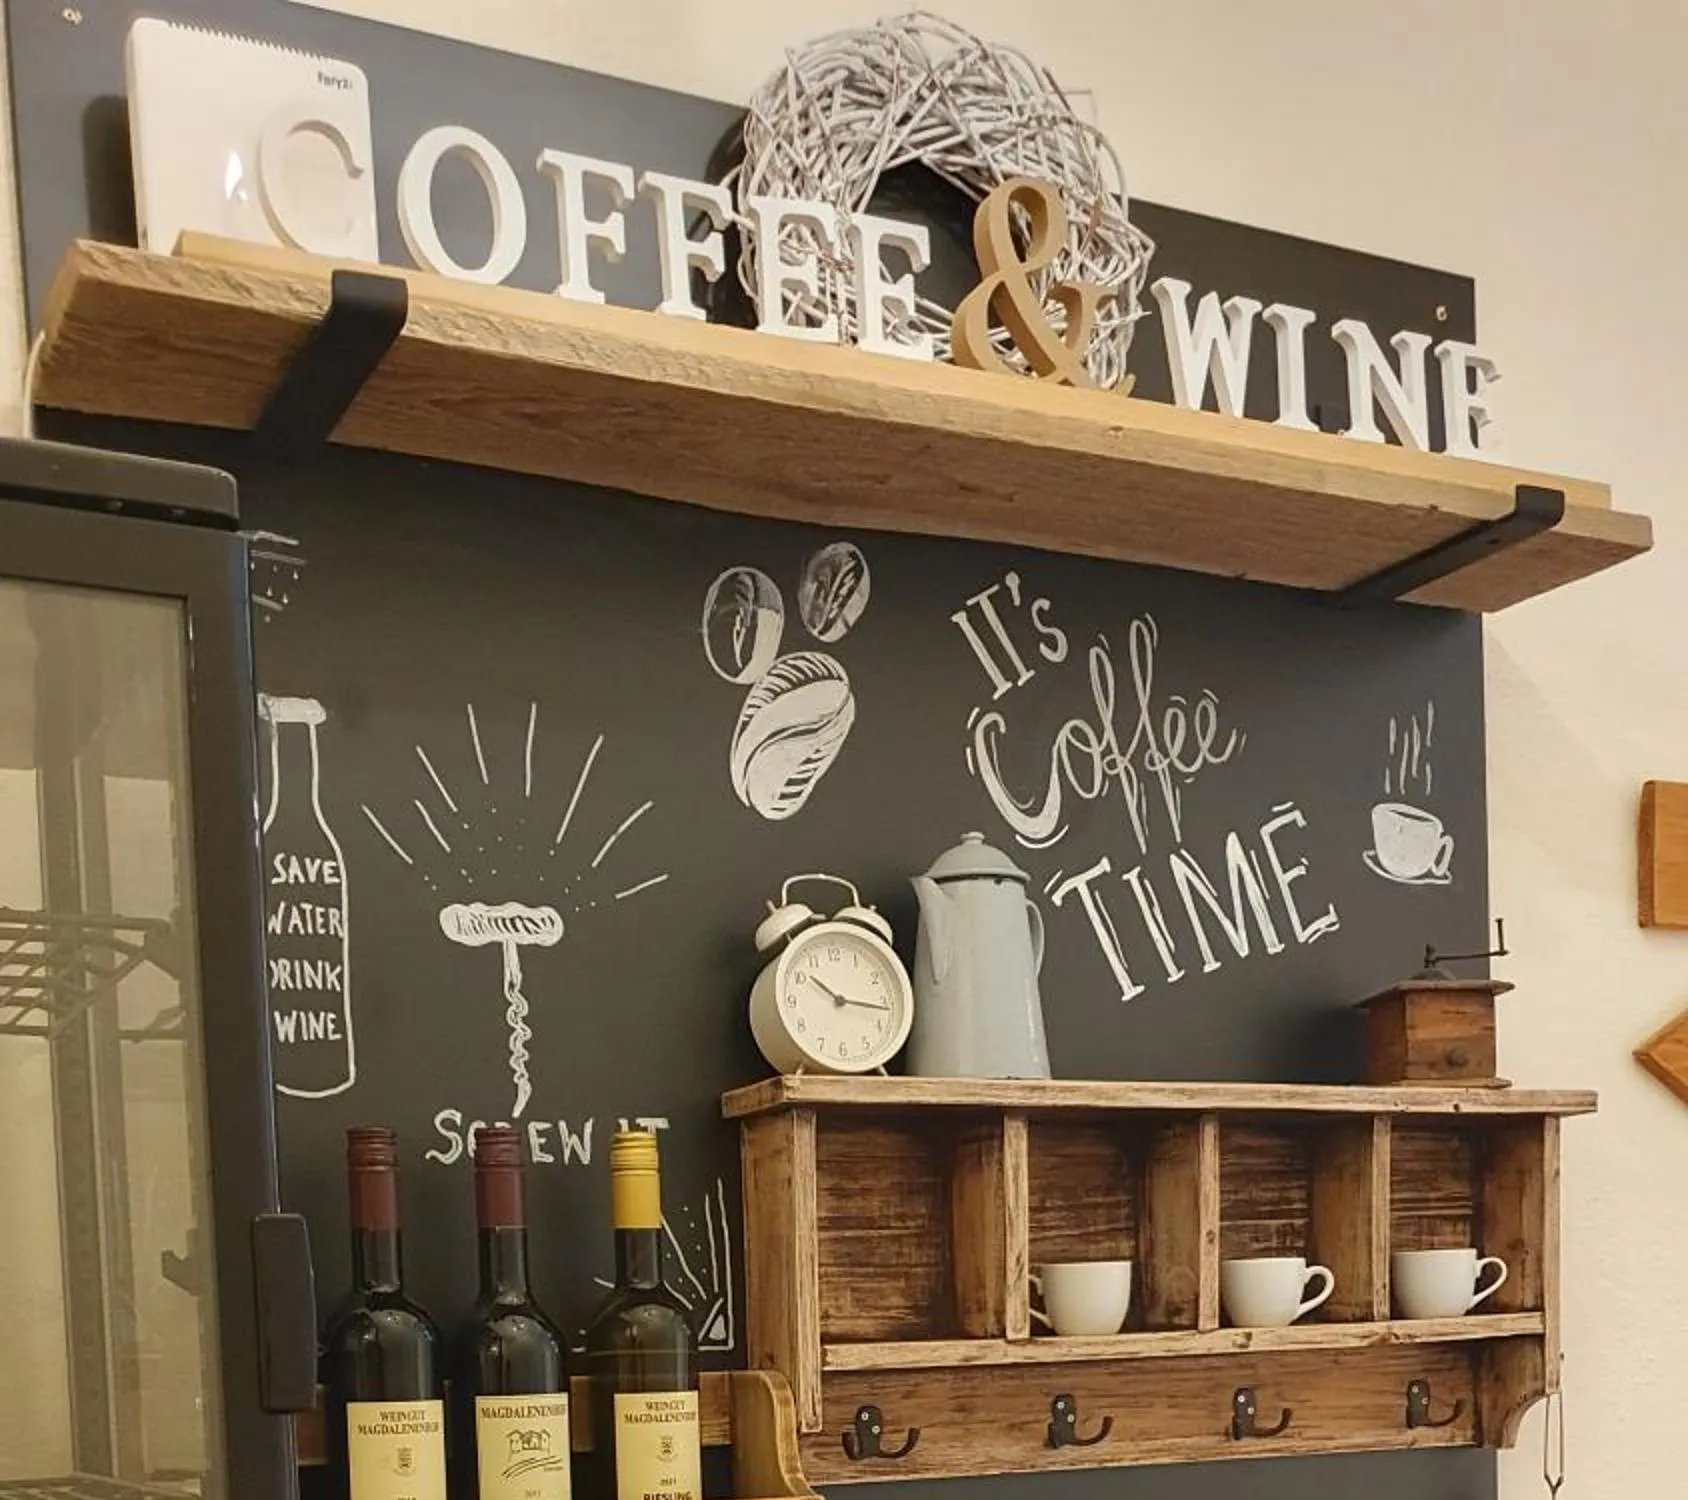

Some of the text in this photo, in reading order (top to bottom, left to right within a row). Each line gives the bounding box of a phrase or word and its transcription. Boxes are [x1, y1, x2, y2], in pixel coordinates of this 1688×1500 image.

[255, 100, 1502, 459] COFFEE & WINE
[967, 614, 1243, 853] Coffee
[271, 852, 341, 885] SAVE
[1047, 806, 1340, 1002] TIME
[827, 947, 841, 962] 12
[870, 970, 880, 985] 2
[787, 995, 798, 1009] 9
[273, 1010, 343, 1044] WINE
[797, 1018, 807, 1033] 8
[817, 1036, 825, 1052] 7
[838, 1041, 848, 1057] 6
[425, 1108, 593, 1166] SCEW
